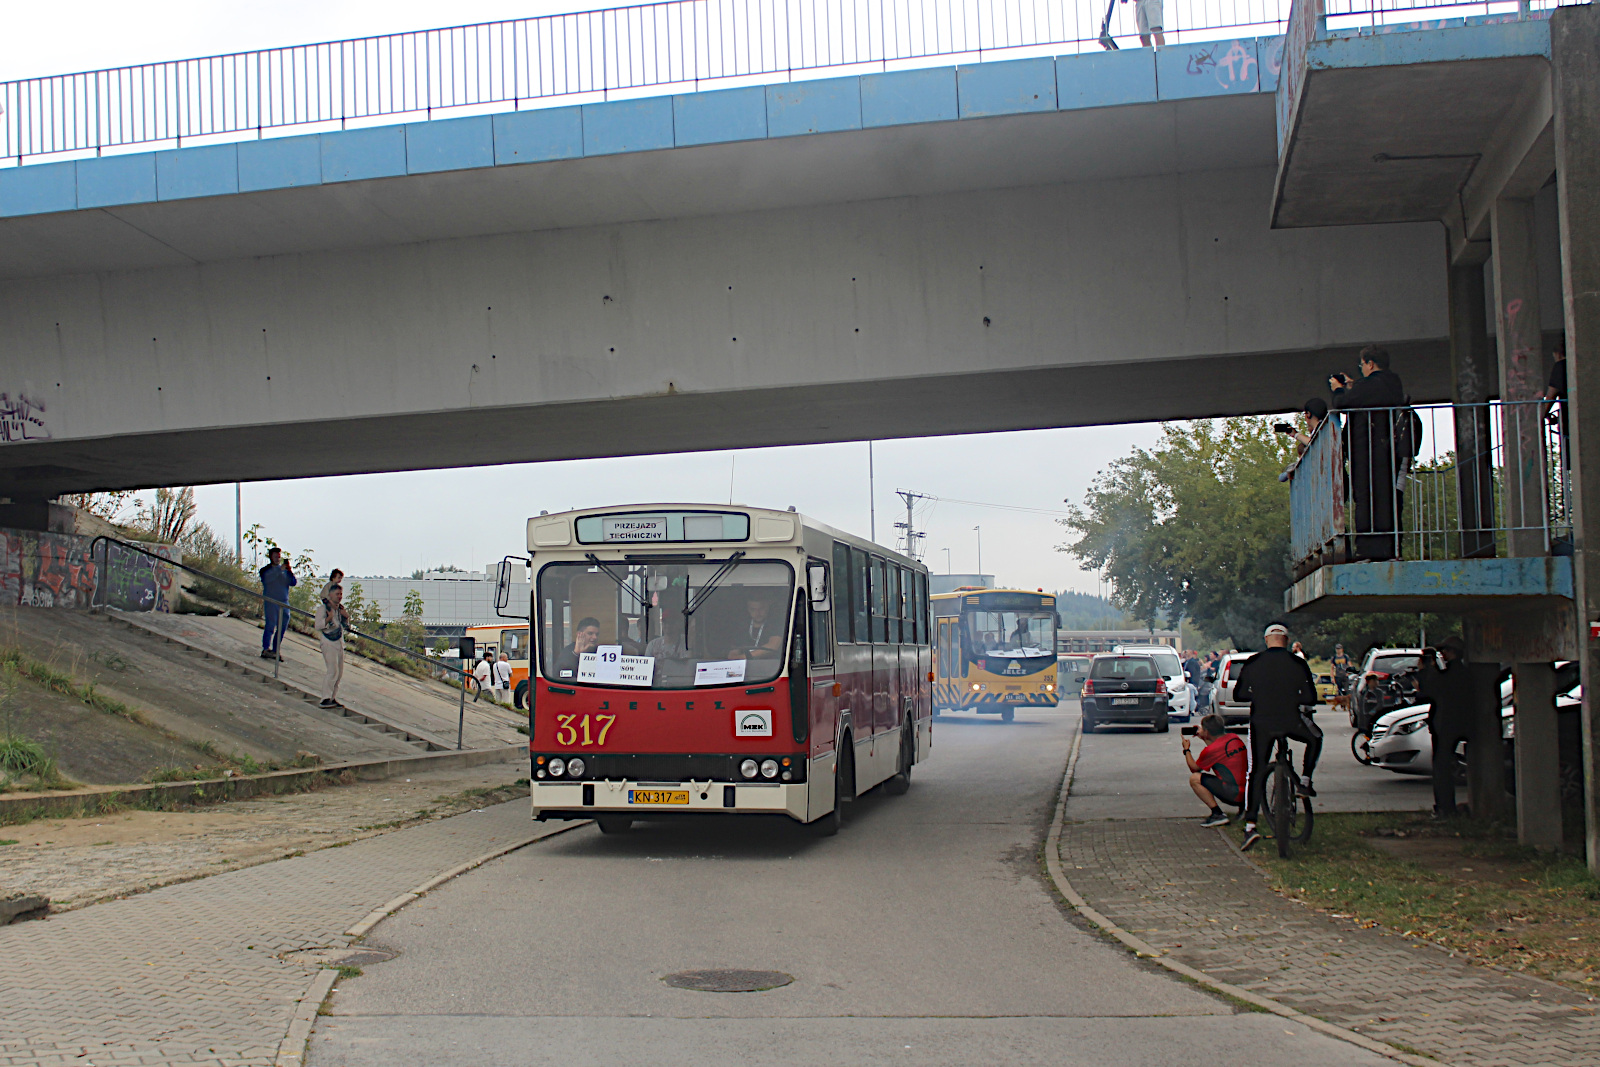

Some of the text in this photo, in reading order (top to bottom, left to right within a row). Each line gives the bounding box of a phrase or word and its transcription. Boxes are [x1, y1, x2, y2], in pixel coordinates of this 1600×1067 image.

[601, 652, 617, 662] 19
[598, 701, 726, 710] JELCZ
[556, 713, 617, 746] 317
[635, 791, 673, 803] KN 317
